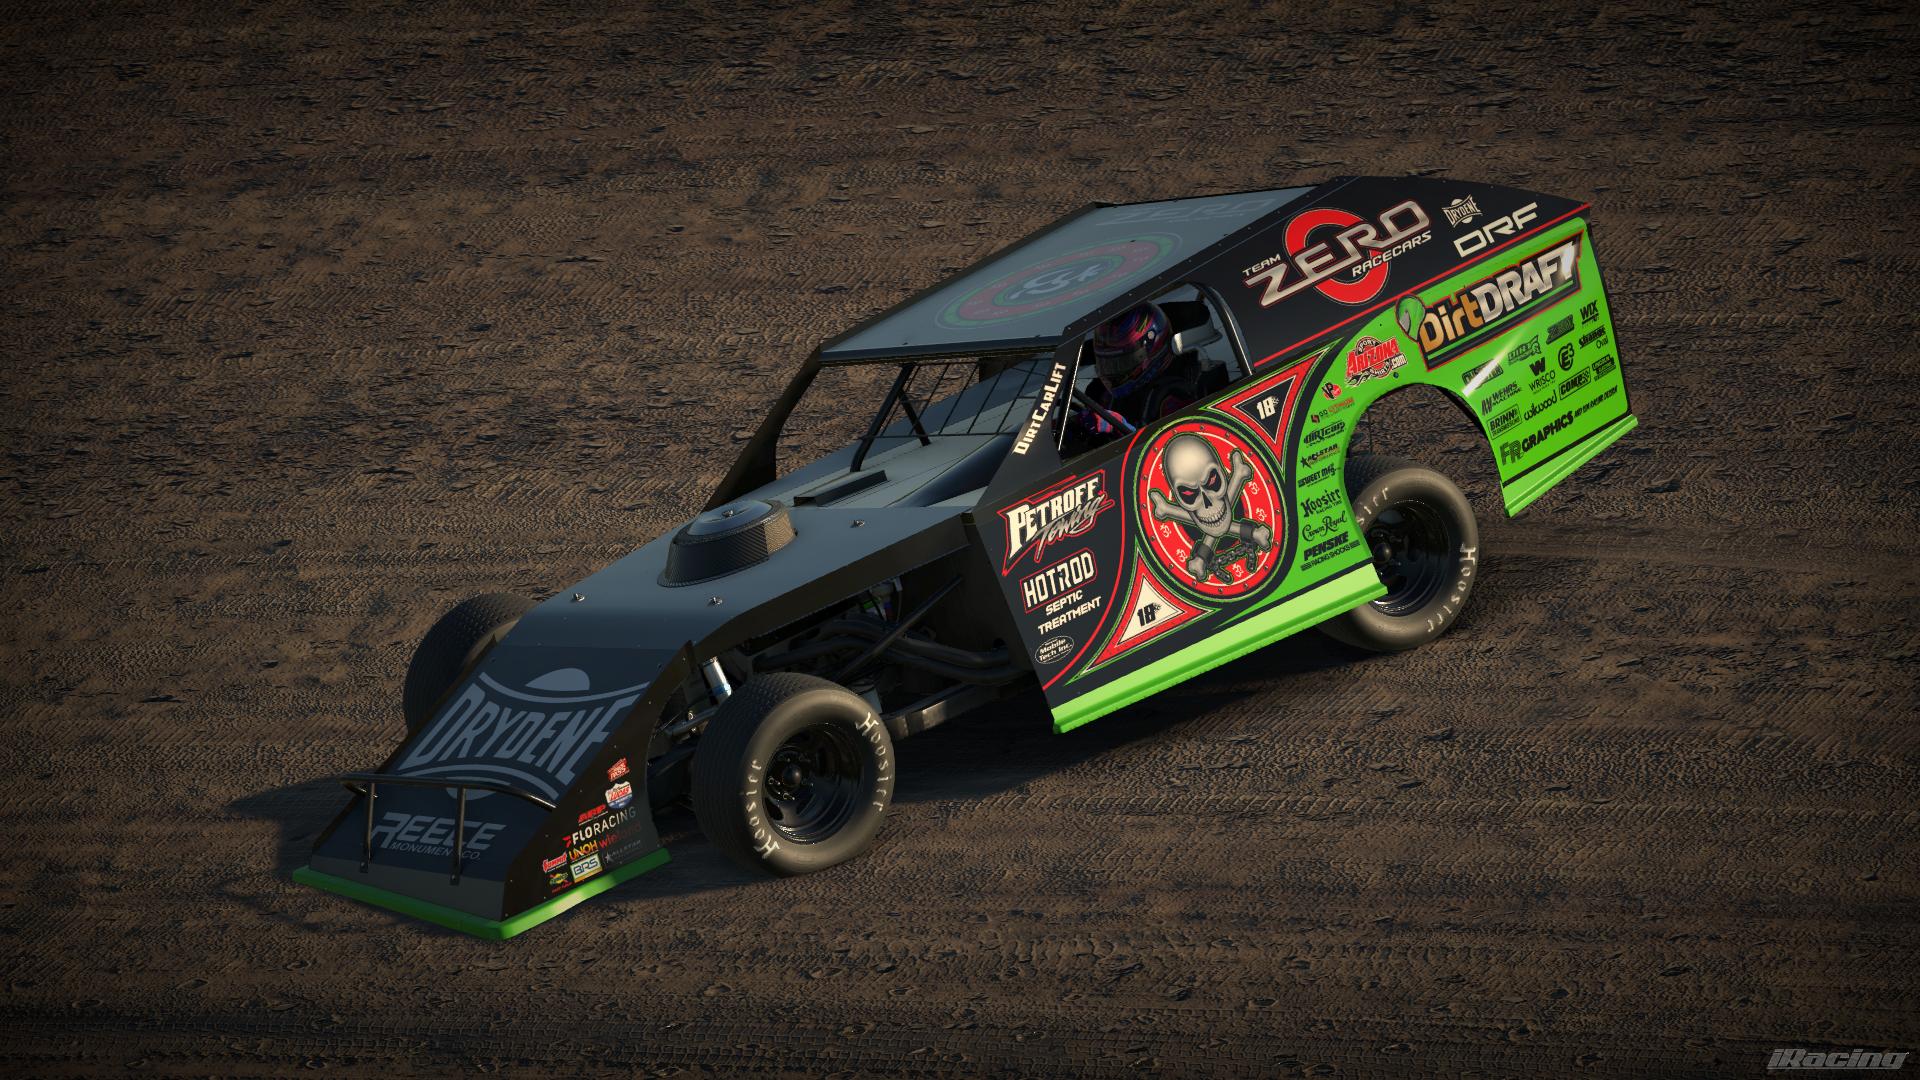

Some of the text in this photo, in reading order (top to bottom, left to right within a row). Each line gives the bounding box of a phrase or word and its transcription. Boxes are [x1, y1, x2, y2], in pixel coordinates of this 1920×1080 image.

[1443, 198, 1481, 224] DRYDENE
[1243, 254, 1282, 276] TEAM
[1245, 200, 1430, 307] ZERO
[1352, 230, 1432, 278] RACECARS
[1580, 300, 1599, 321] WIX
[1347, 338, 1400, 378] ARIZONA
[1529, 370, 1556, 391] WRISCO
[1489, 408, 1516, 430] BRINN
[1522, 411, 1574, 452] GRAPHICS
[1301, 488, 1341, 517] Hoosier
[1304, 531, 1349, 561] PENSKE
[1045, 589, 1083, 616] SEPTIC
[1038, 596, 1102, 636] TREATMENT
[1039, 650, 1057, 662] Tech
[1040, 639, 1066, 654] Mobile
[399, 682, 642, 788] DRYDENE
[371, 811, 507, 851] REECE
[390, 841, 456, 857] MONUMEN
[568, 840, 598, 860] UNOH
[573, 857, 599, 876] BRS
